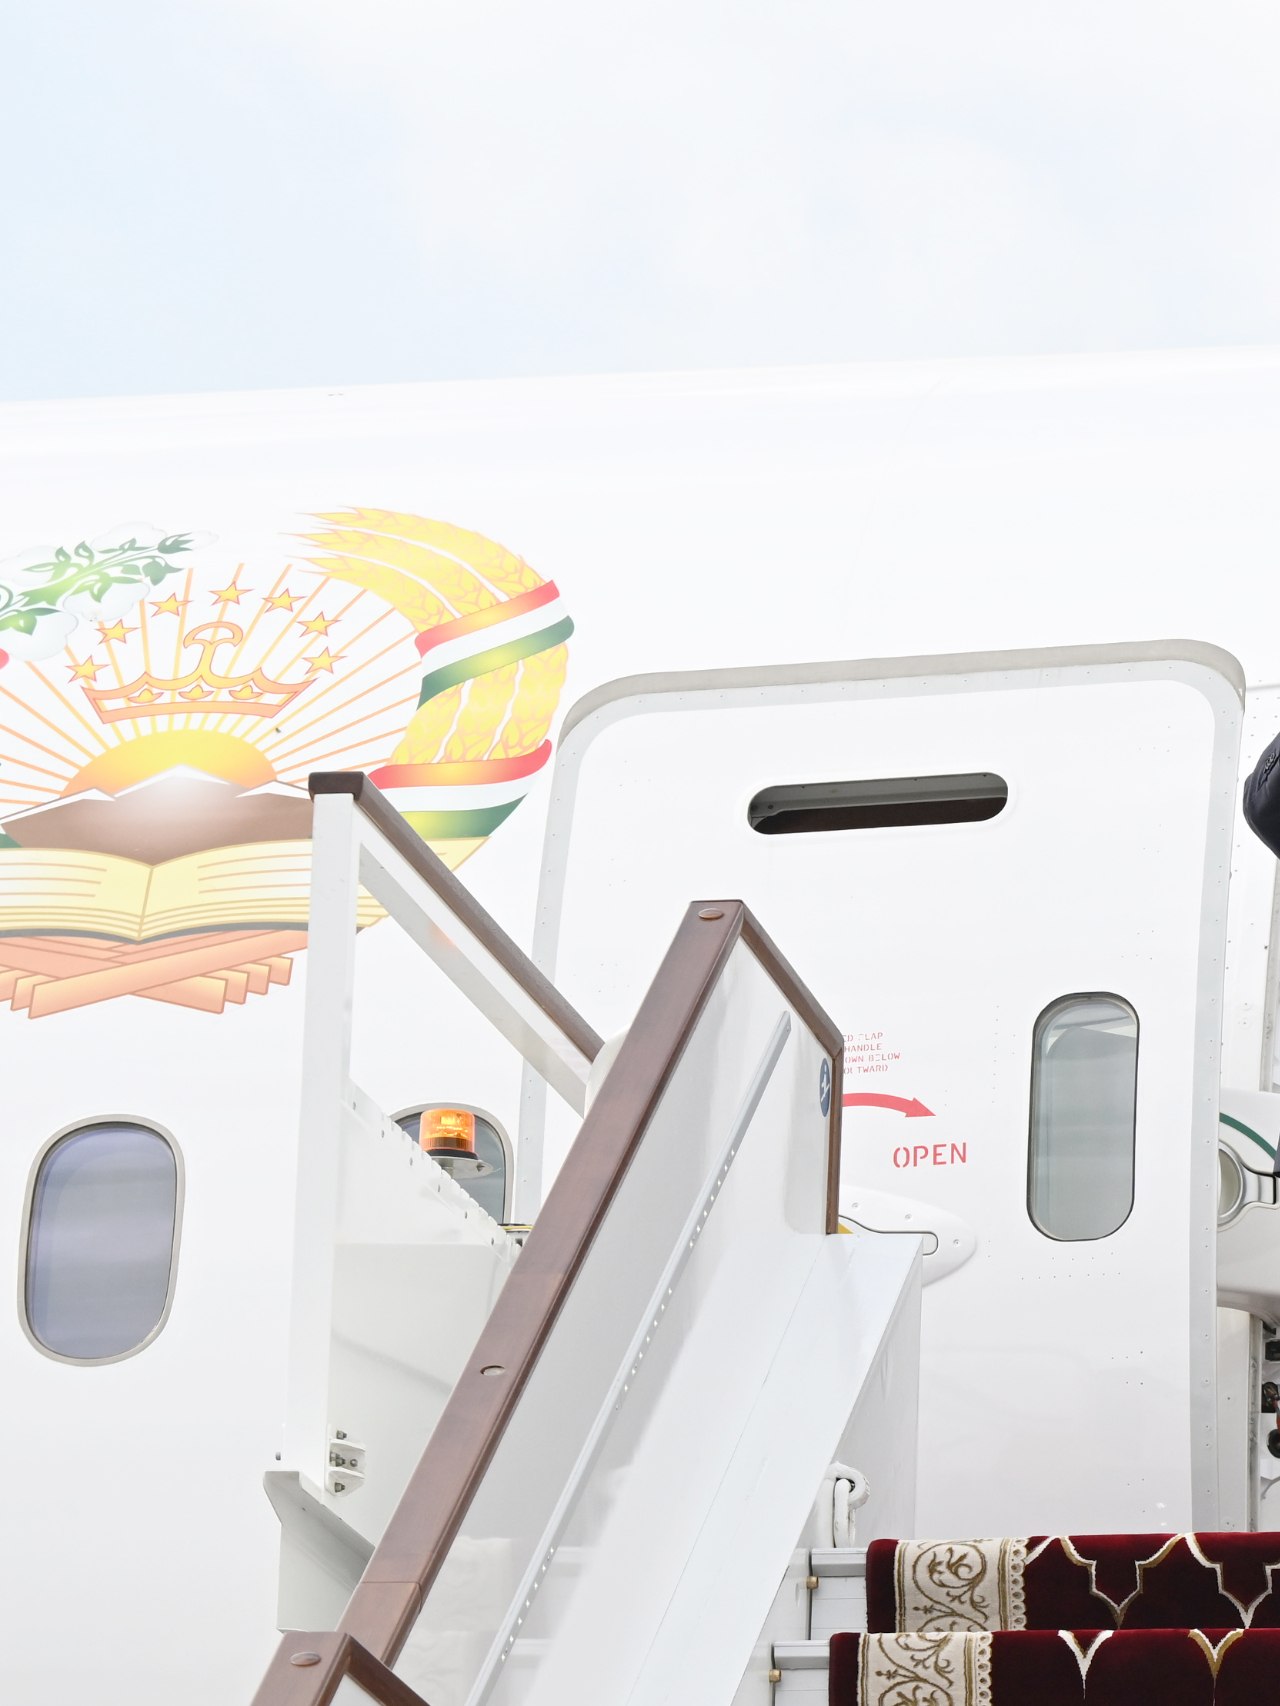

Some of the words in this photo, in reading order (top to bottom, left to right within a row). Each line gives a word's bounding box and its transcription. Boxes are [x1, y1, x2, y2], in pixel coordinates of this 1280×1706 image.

[844, 1043, 882, 1053] HANDLE
[869, 1052, 901, 1062] BELOW
[893, 1142, 967, 1168] OPEN
